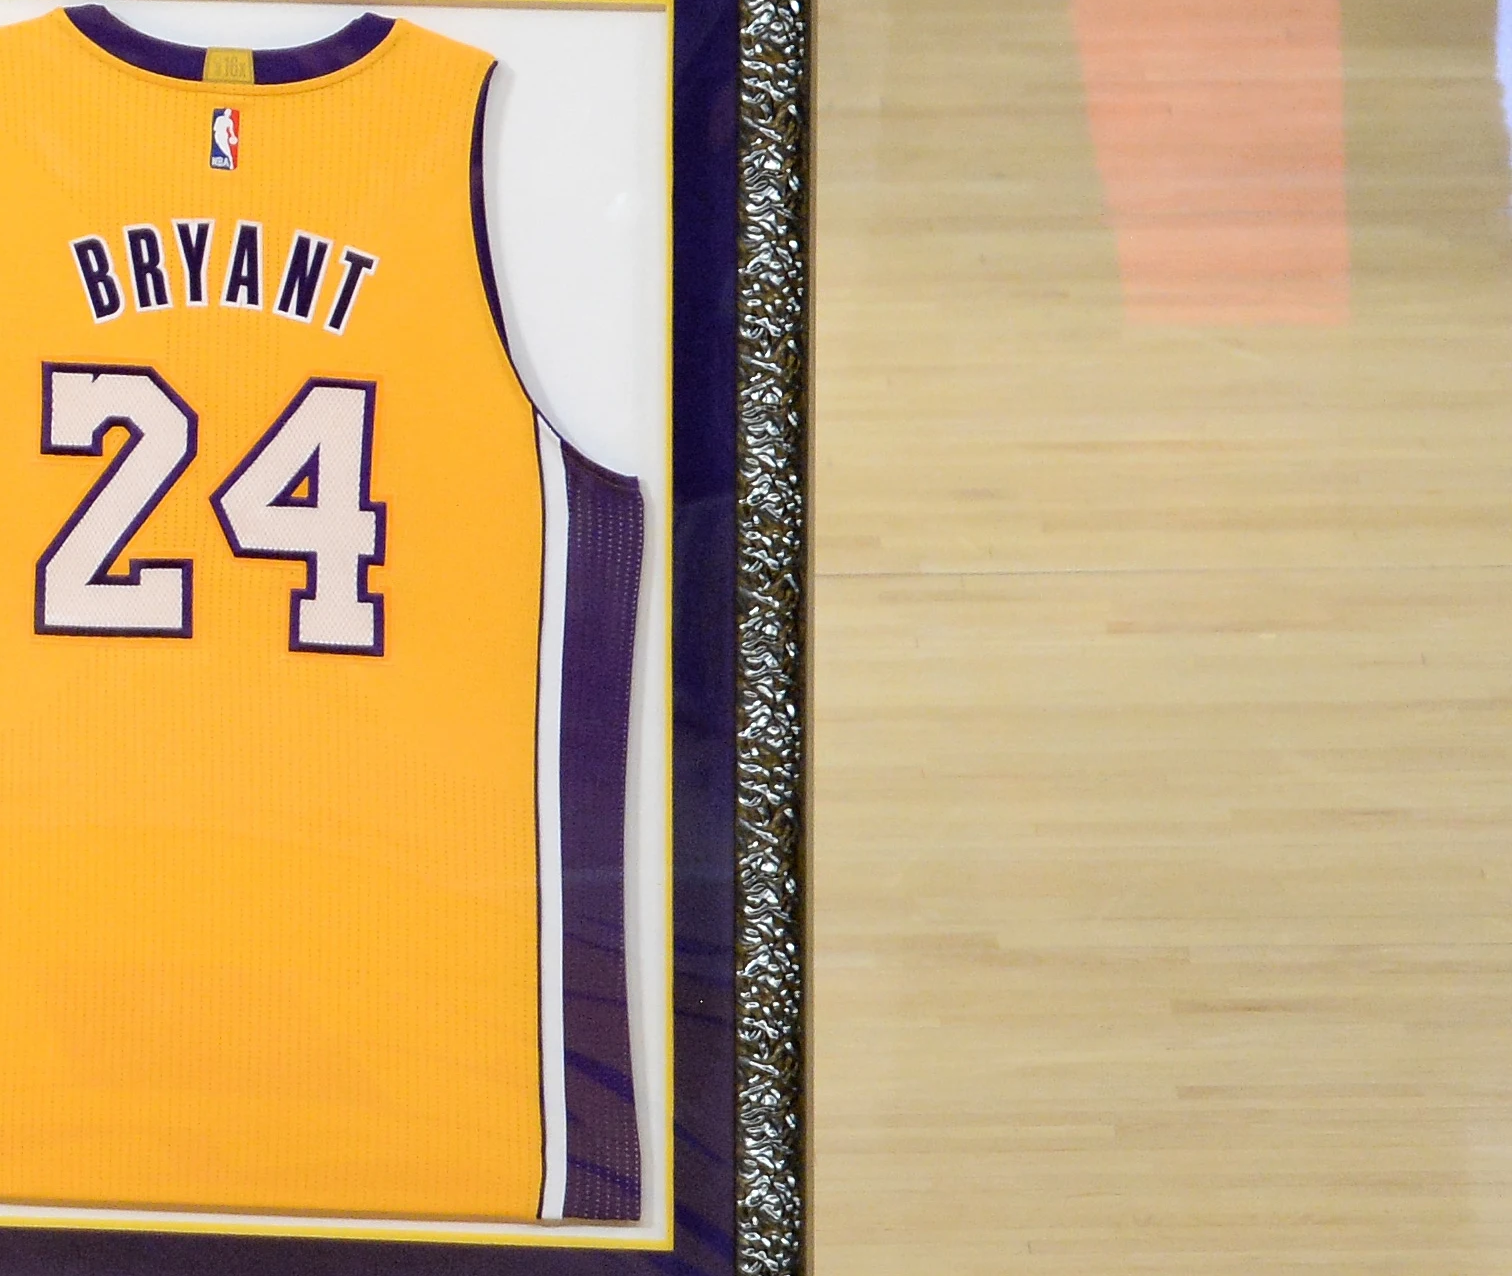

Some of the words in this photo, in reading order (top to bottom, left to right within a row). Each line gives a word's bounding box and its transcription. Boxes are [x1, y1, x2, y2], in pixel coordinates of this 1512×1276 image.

[211, 156, 230, 168] NBA
[69, 217, 380, 337] BRYANT
[34, 361, 387, 658] 24
